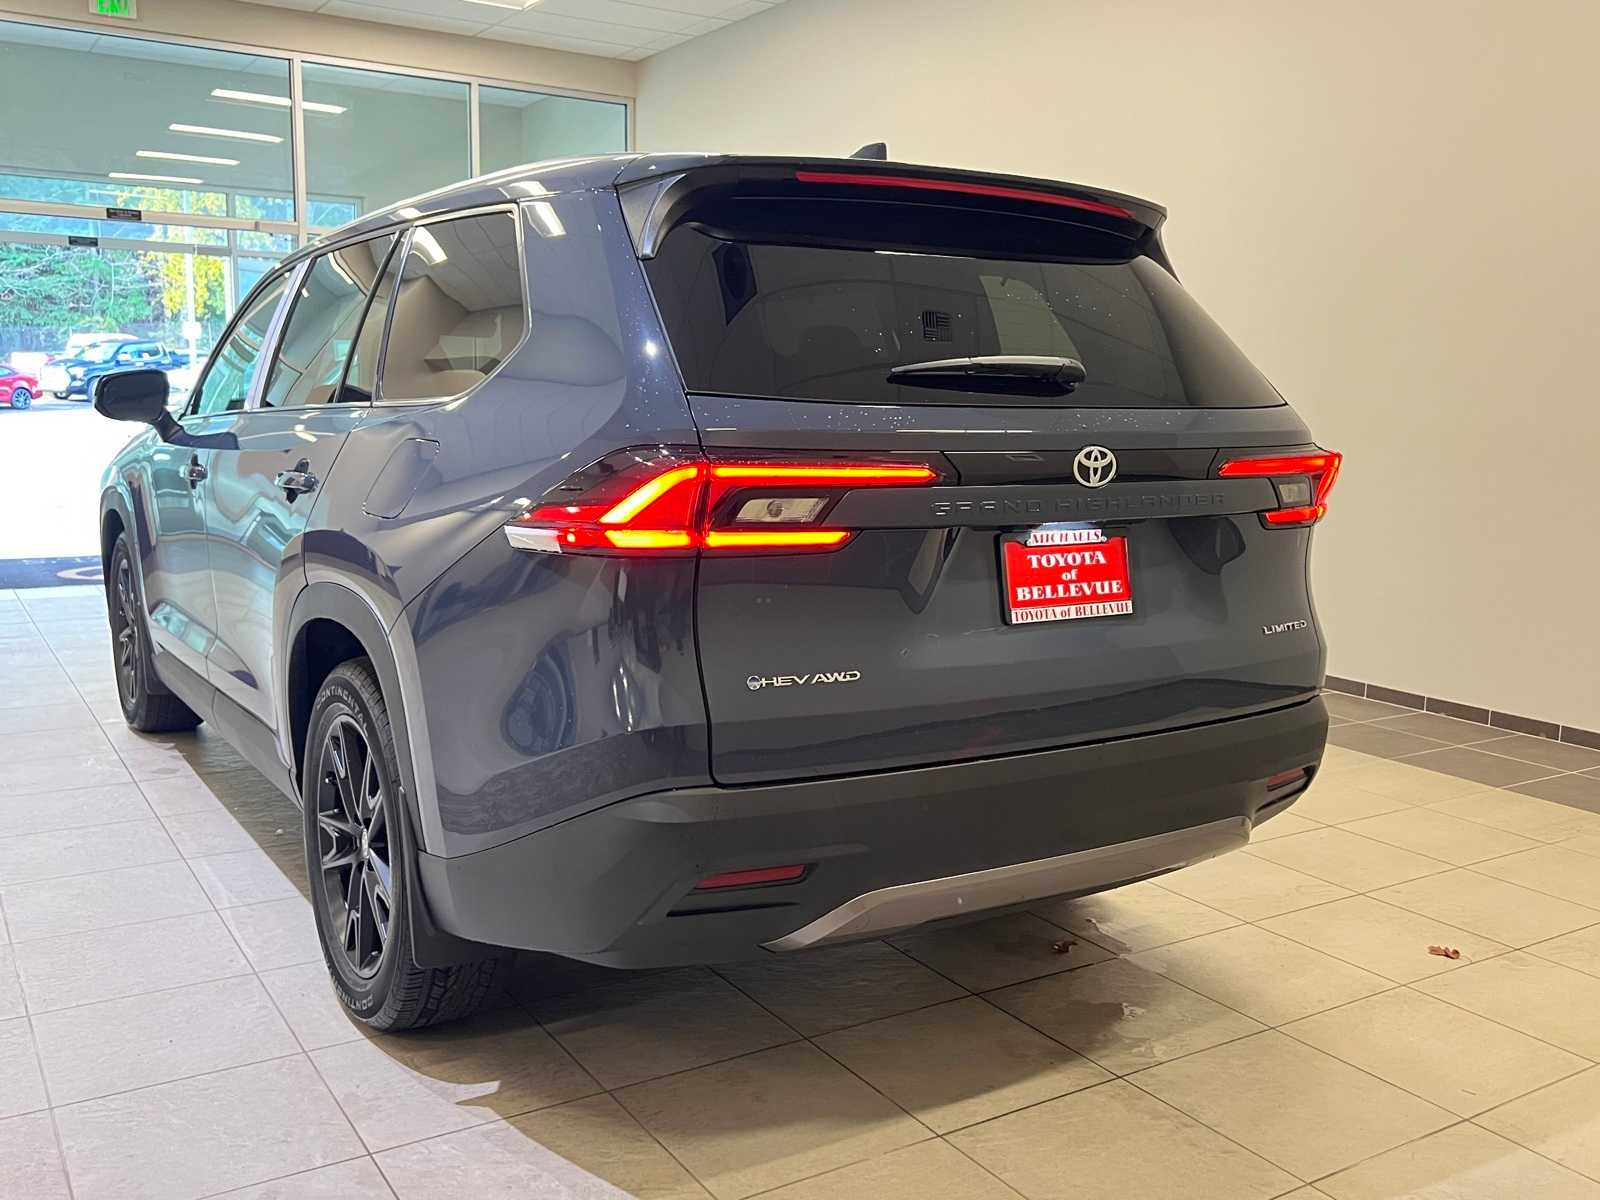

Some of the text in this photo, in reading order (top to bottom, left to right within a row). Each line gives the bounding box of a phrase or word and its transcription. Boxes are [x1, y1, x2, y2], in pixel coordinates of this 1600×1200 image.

[931, 494, 1225, 516] GRAND HIGHLANDER
[1027, 551, 1107, 568] TOYOTA
[1061, 569, 1078, 581] of
[1016, 580, 1123, 602] BELLEVUE
[1013, 601, 1132, 623] TOYOTA of BELLEVUE
[1262, 619, 1307, 635] LIMITED
[759, 670, 861, 688] HEV AWD
